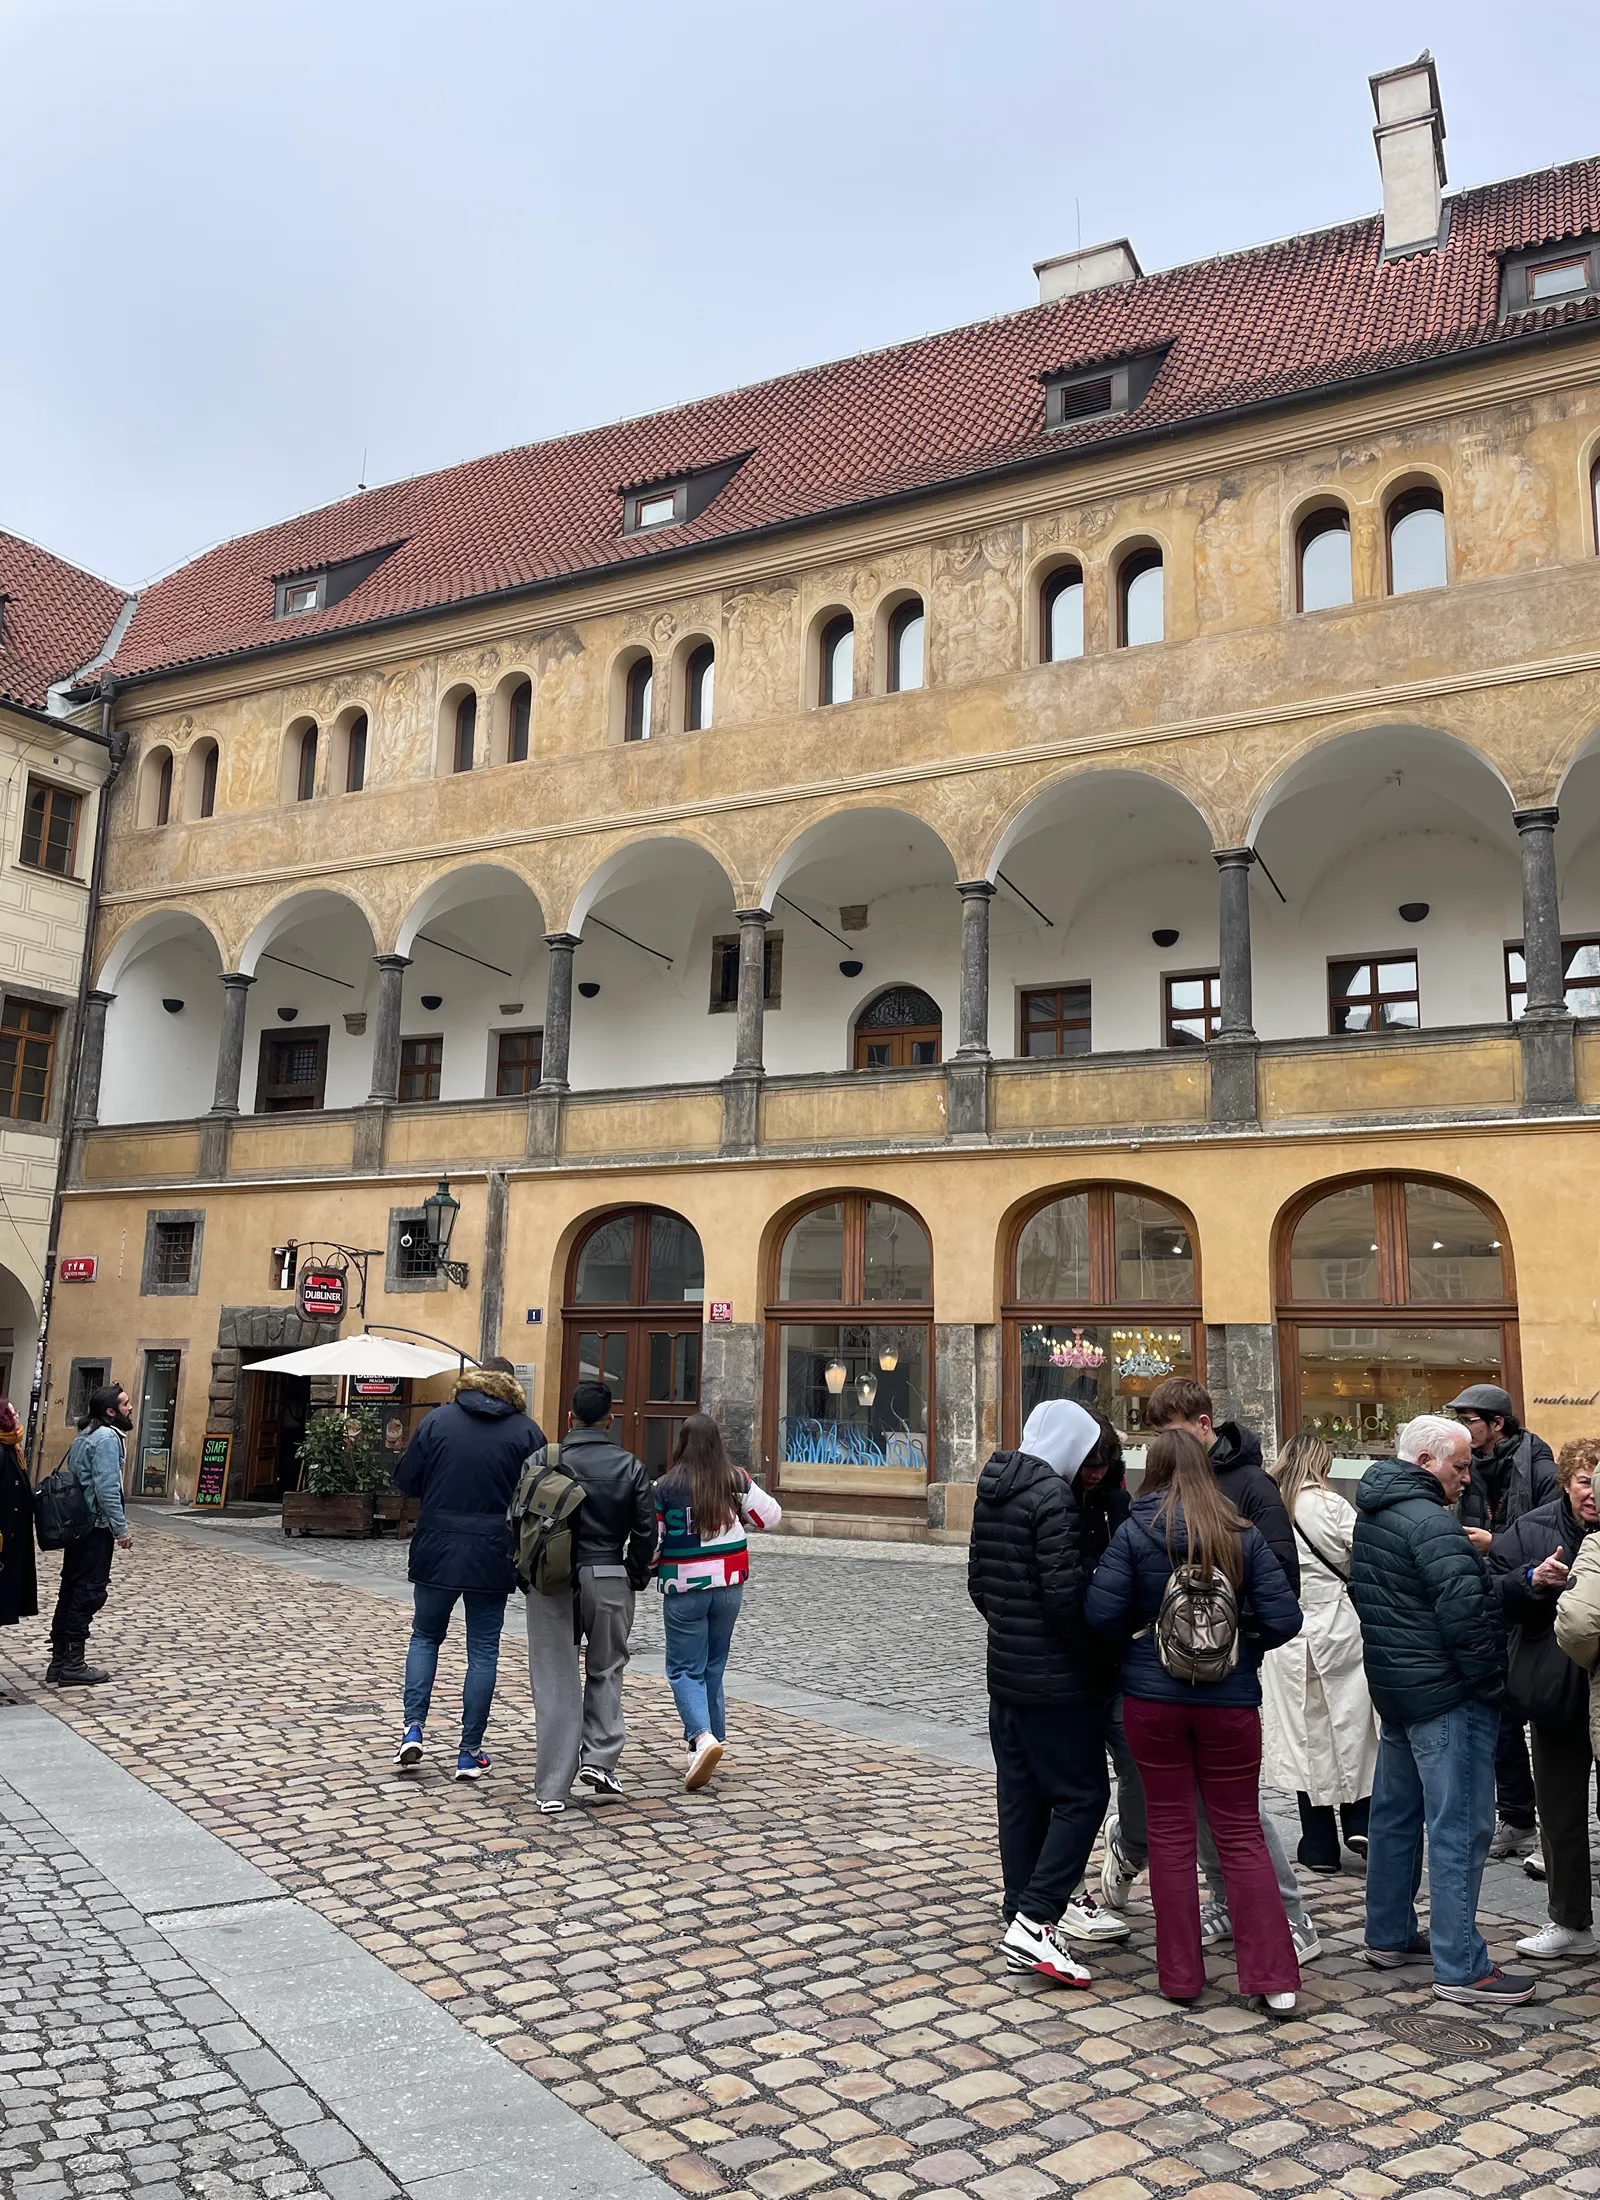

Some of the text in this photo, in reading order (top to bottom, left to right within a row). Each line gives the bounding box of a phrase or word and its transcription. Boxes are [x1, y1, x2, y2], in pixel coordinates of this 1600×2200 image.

[68, 1262, 84, 1270] TÝN
[305, 1290, 340, 1301] DUBLINER
[1534, 1391, 1600, 1405] material
[206, 1441, 227, 1454] STAFF
